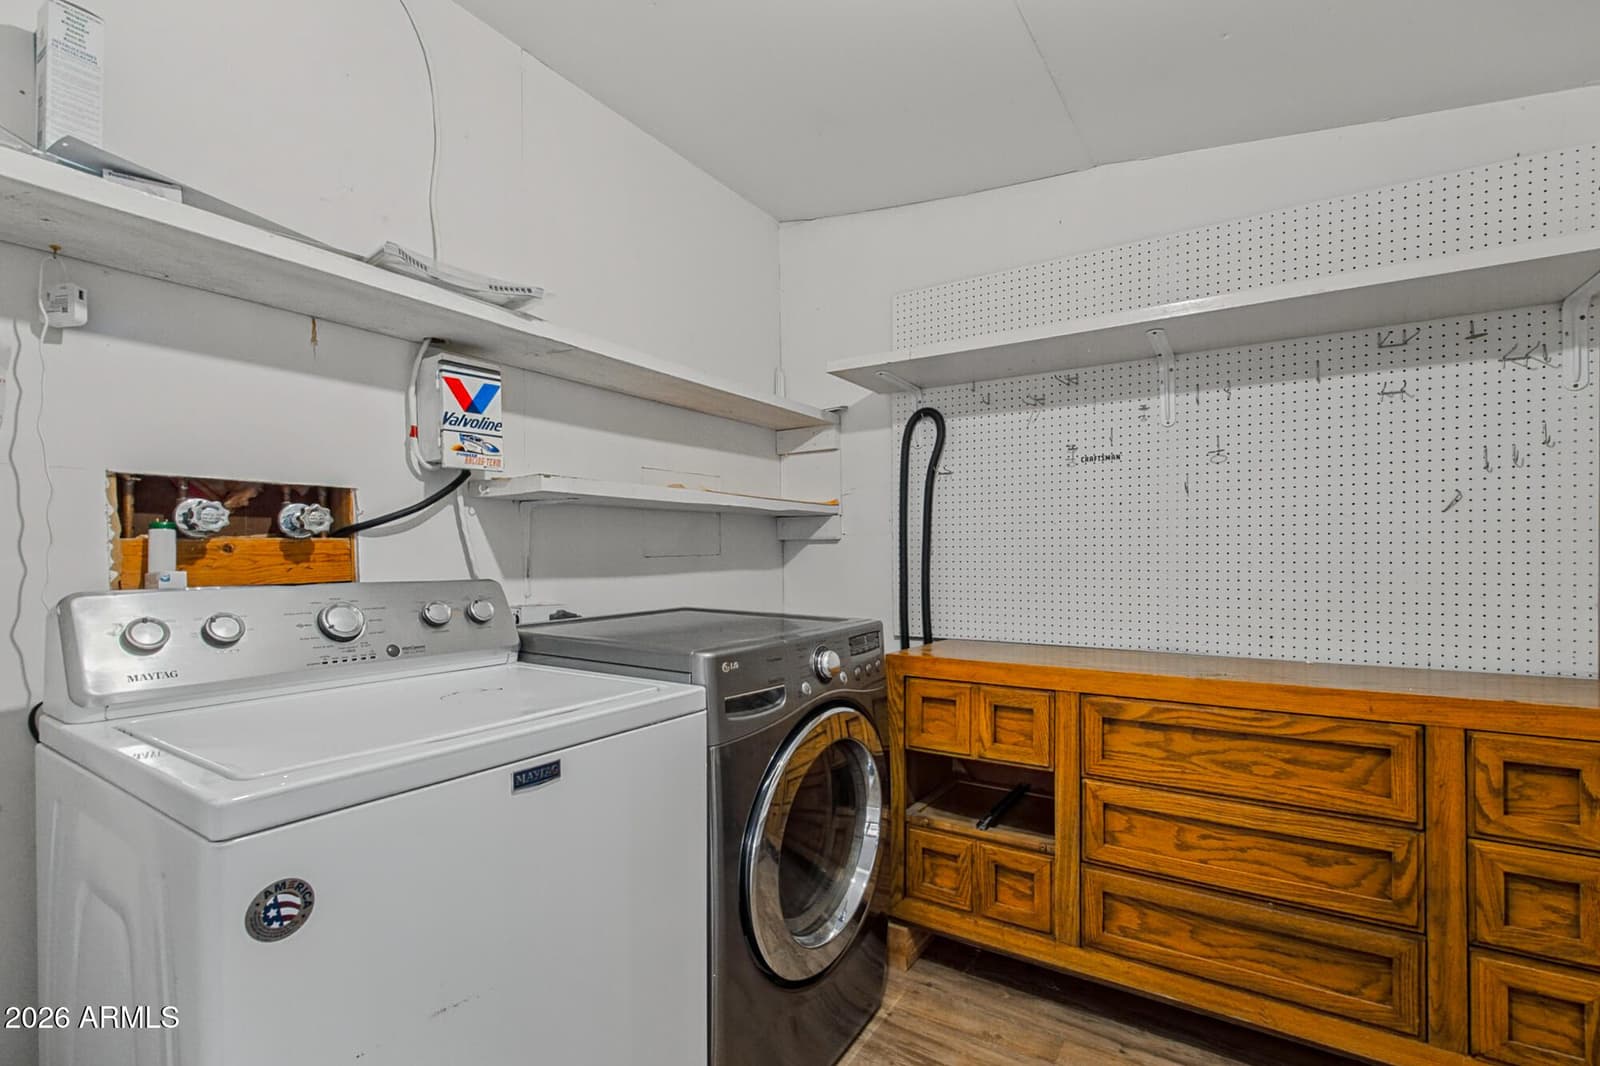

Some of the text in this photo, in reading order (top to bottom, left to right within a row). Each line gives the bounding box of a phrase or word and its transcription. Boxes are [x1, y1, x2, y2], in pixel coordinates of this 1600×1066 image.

[443, 411, 503, 432] Valvoline
[1081, 454, 1121, 463] CRAFTSMAN
[127, 670, 178, 683] MAYTAG
[515, 764, 559, 786] MAYTAG
[264, 880, 312, 909] AMERICA
